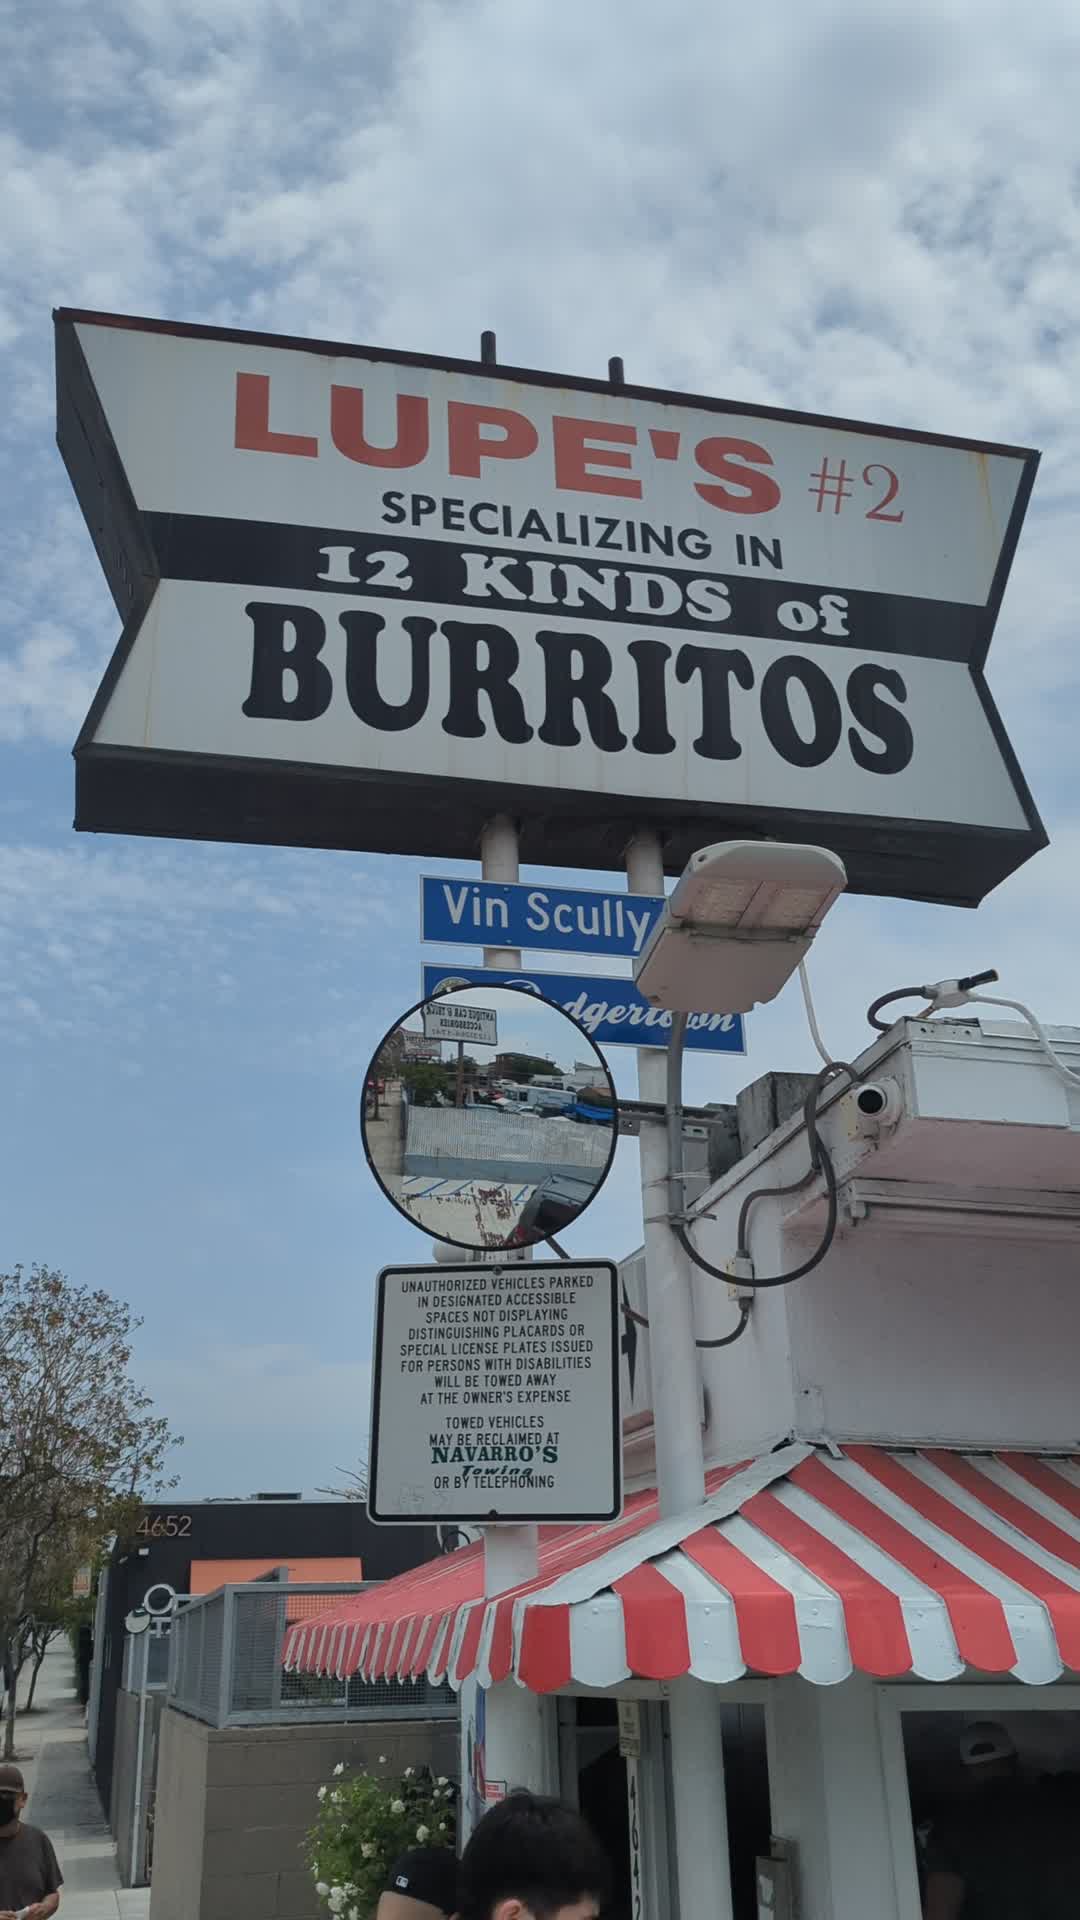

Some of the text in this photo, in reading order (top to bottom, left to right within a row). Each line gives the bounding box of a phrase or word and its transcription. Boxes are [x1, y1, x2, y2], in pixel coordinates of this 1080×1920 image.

[235, 372, 904, 523] LUPE'S #2
[381, 491, 784, 569] SPECIALIZING IN
[317, 546, 850, 639] 12 KINDS of
[242, 601, 915, 774] BURRITOS
[442, 885, 651, 951] Vin Scully
[402, 1276, 593, 1292] UNAUTHORIZED VEHICLES PARKED
[417, 1292, 576, 1307] IN DESIGNATED ACCESSIBLE
[426, 1308, 568, 1323] SPACES NOT DISPLAYING
[409, 1324, 584, 1340] DISTINGUISHING PLACARDS OR
[400, 1340, 593, 1356] SPECIAL LICENSE PLATES ISSUED
[401, 1357, 591, 1372] FOR PERSONS WITH DISABILITIES
[435, 1374, 557, 1388] WILL BE TOWED AWAY
[420, 1390, 571, 1405] AT THE OWNER'S EXPENSE
[446, 1416, 544, 1429] TOWED VEHICLES
[430, 1433, 559, 1446] MAY BE RECLAIMED AT
[431, 1446, 558, 1464] NAVARRO'S
[462, 1465, 533, 1477] Towing
[434, 1475, 554, 1489] OR BY TELEPHONING
[136, 1515, 192, 1537] 4652
